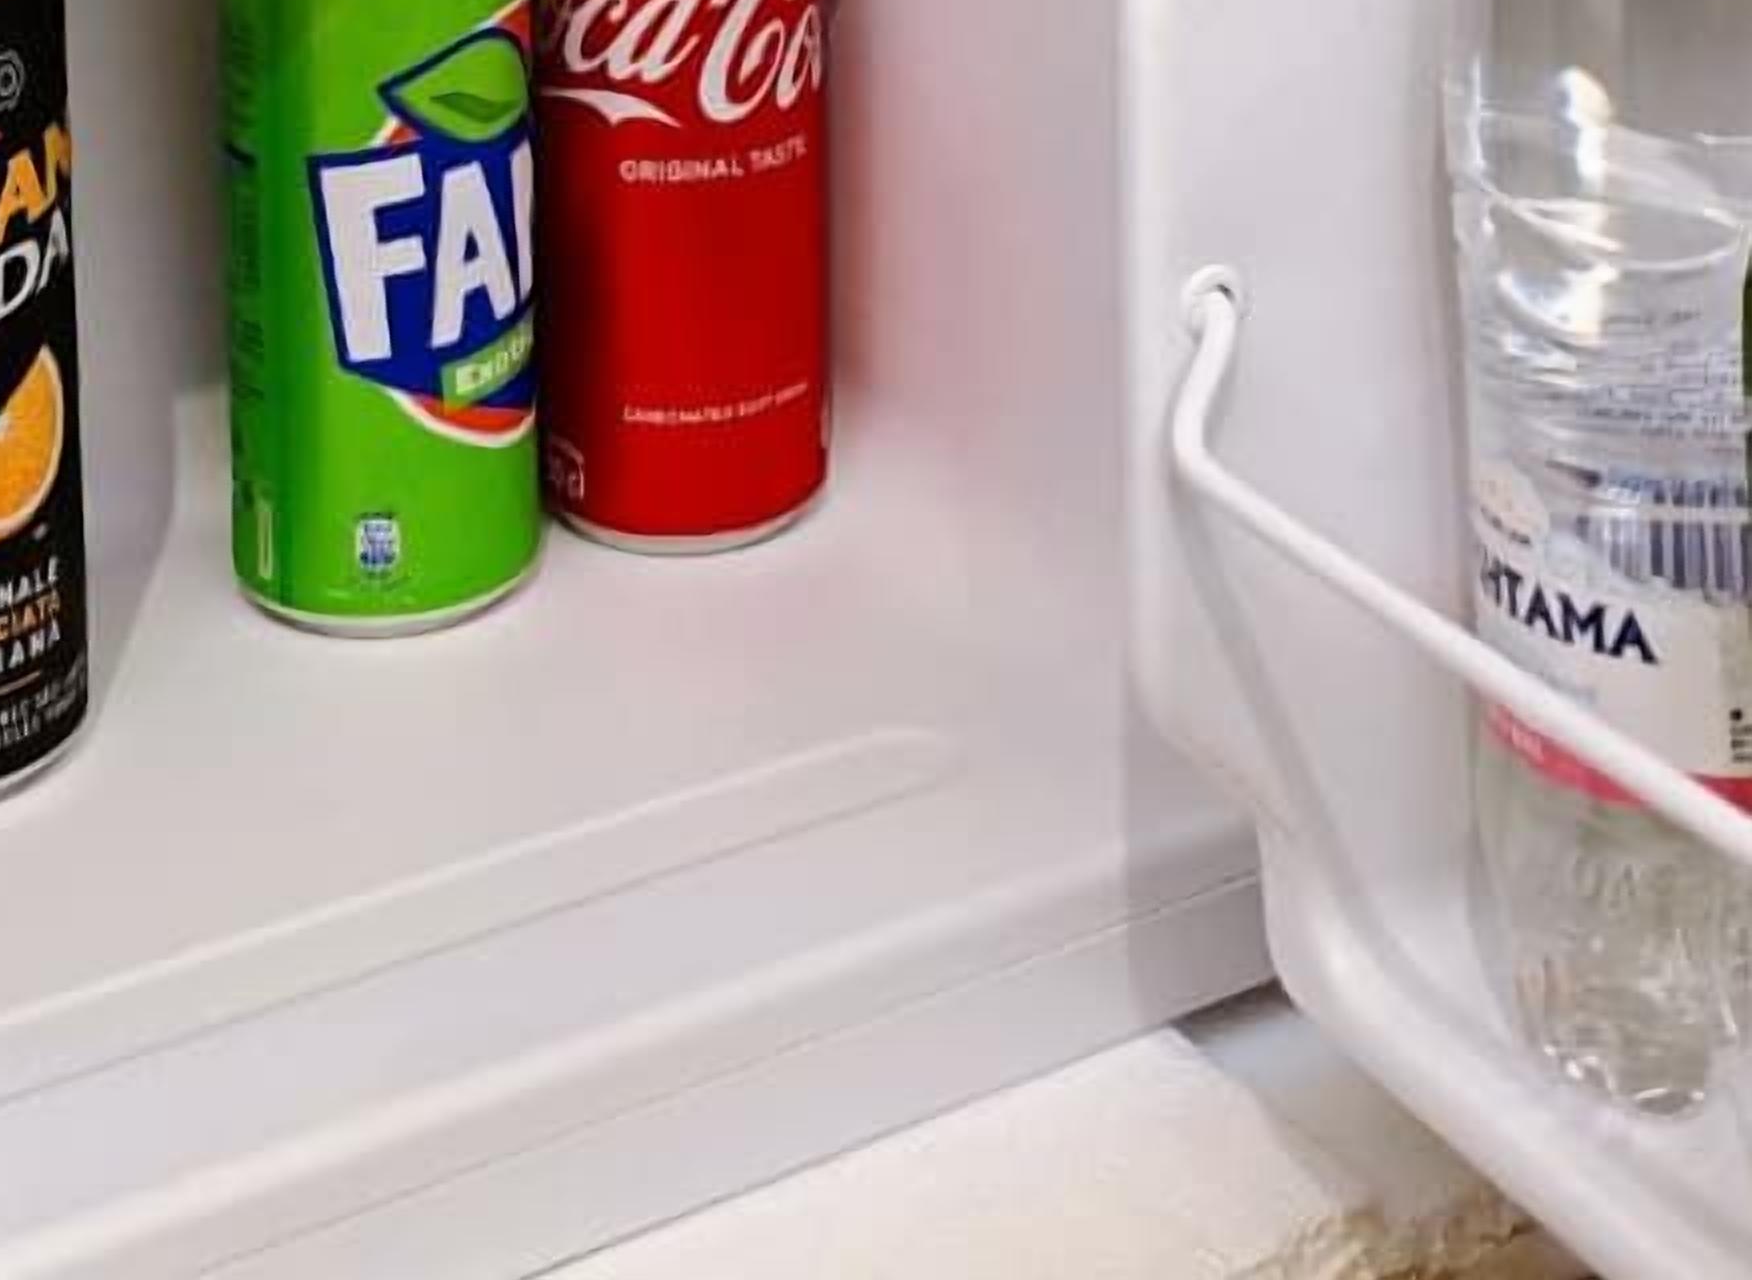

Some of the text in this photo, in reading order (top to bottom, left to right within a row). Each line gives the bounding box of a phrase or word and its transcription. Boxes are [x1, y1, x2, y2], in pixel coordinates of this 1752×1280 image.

[619, 134, 808, 183] ORIGINAL TASTE
[320, 138, 534, 363] FA
